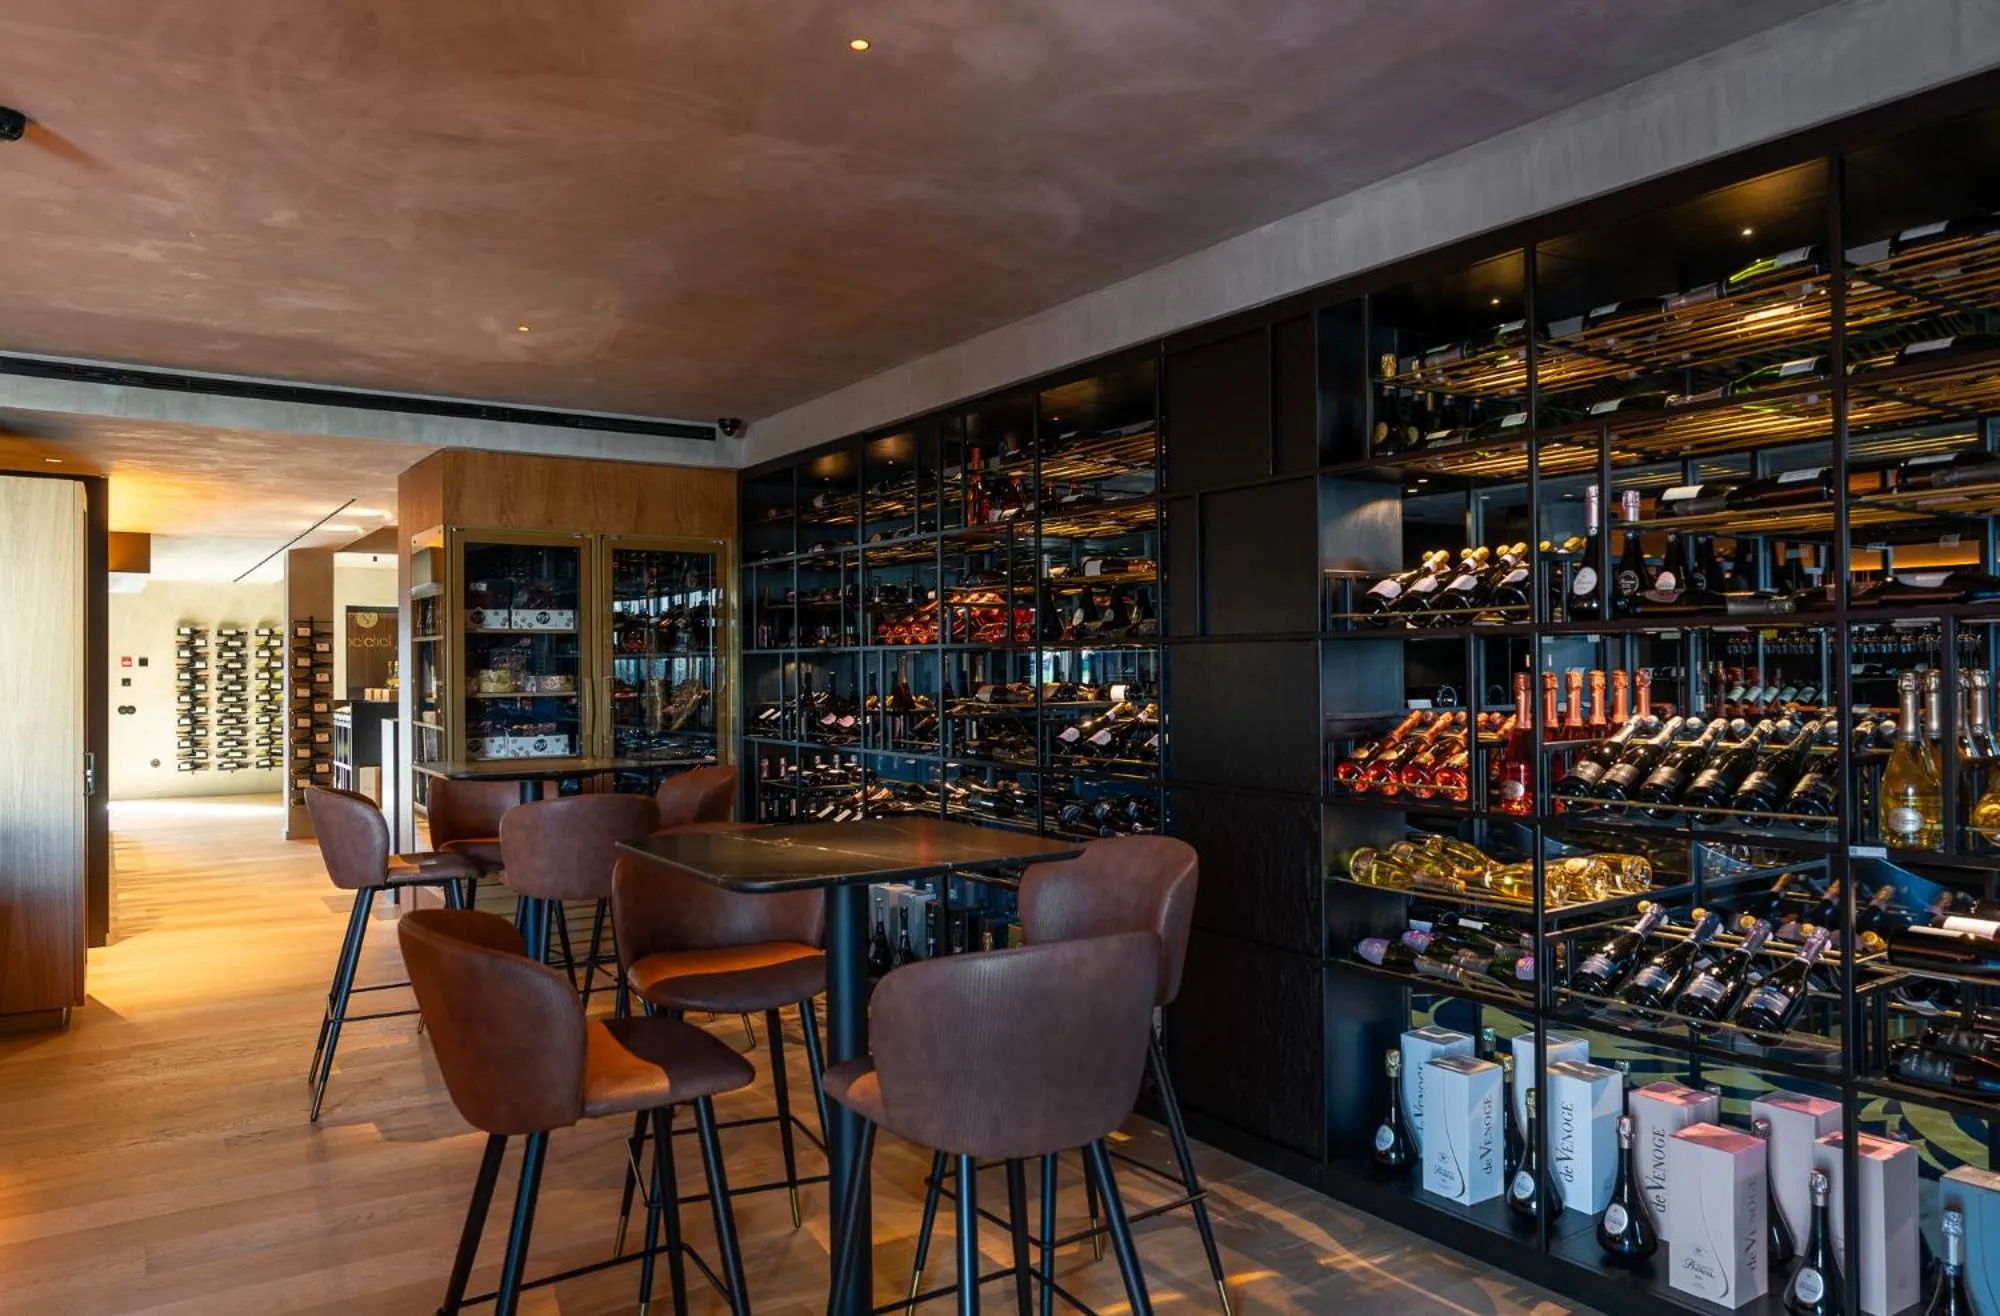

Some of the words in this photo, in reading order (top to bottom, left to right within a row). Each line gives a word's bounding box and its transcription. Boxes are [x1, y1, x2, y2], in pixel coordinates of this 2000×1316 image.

[1479, 1095, 1493, 1159] VENOGE
[1555, 1101, 1575, 1162] VENOGE
[1482, 1158, 1493, 1175] de
[1645, 1125, 1666, 1191] VENOGE
[1559, 1165, 1574, 1183] de
[1649, 1195, 1666, 1213] de
[1746, 1251, 1757, 1271] de
